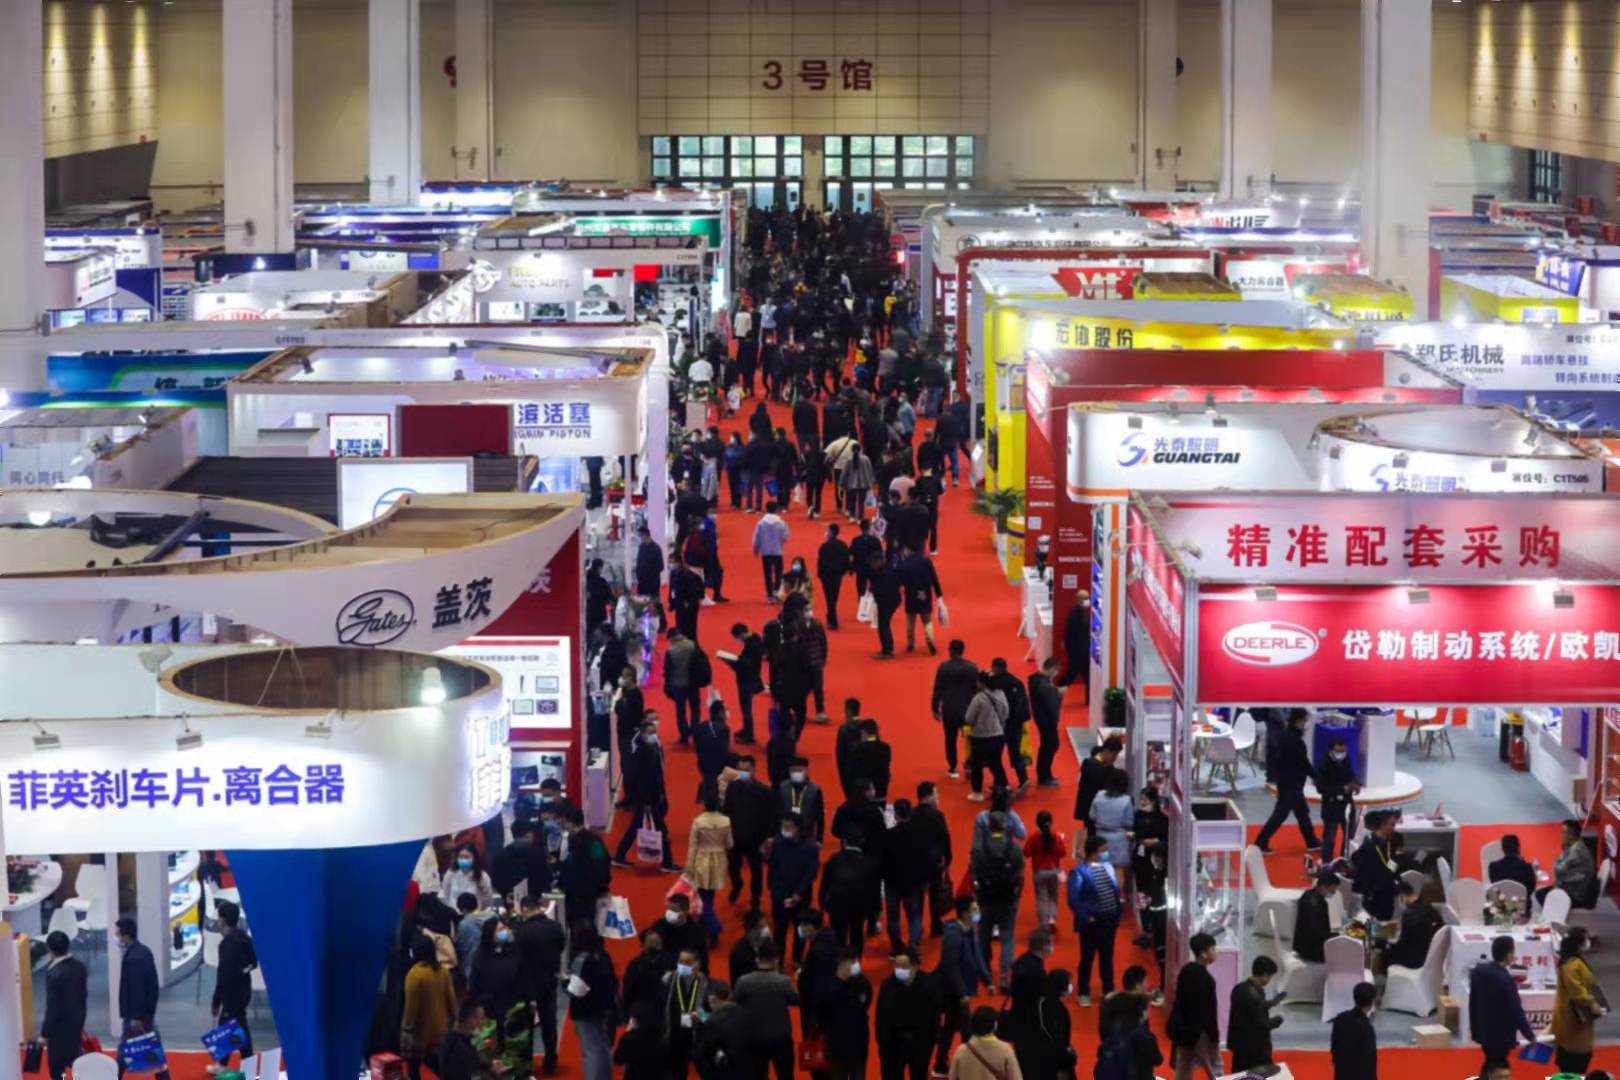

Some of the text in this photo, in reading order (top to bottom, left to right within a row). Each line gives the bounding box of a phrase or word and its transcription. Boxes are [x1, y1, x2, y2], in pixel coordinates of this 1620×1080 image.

[762, 58, 874, 92] 3号馆
[1415, 343, 1505, 365] 郑氏机械
[518, 402, 591, 425] 滨活塞
[549, 428, 592, 439] PISTON
[1153, 437, 1220, 452] 光泰照明
[1153, 452, 1241, 464] GUANGTAI
[1227, 524, 1562, 568] 精准配套采购
[432, 576, 495, 629] 盖茨
[1232, 635, 1309, 650] DEERLE
[8, 763, 346, 811] 菲英刹车片.离合器
[1525, 1012, 1553, 1023] UTO
